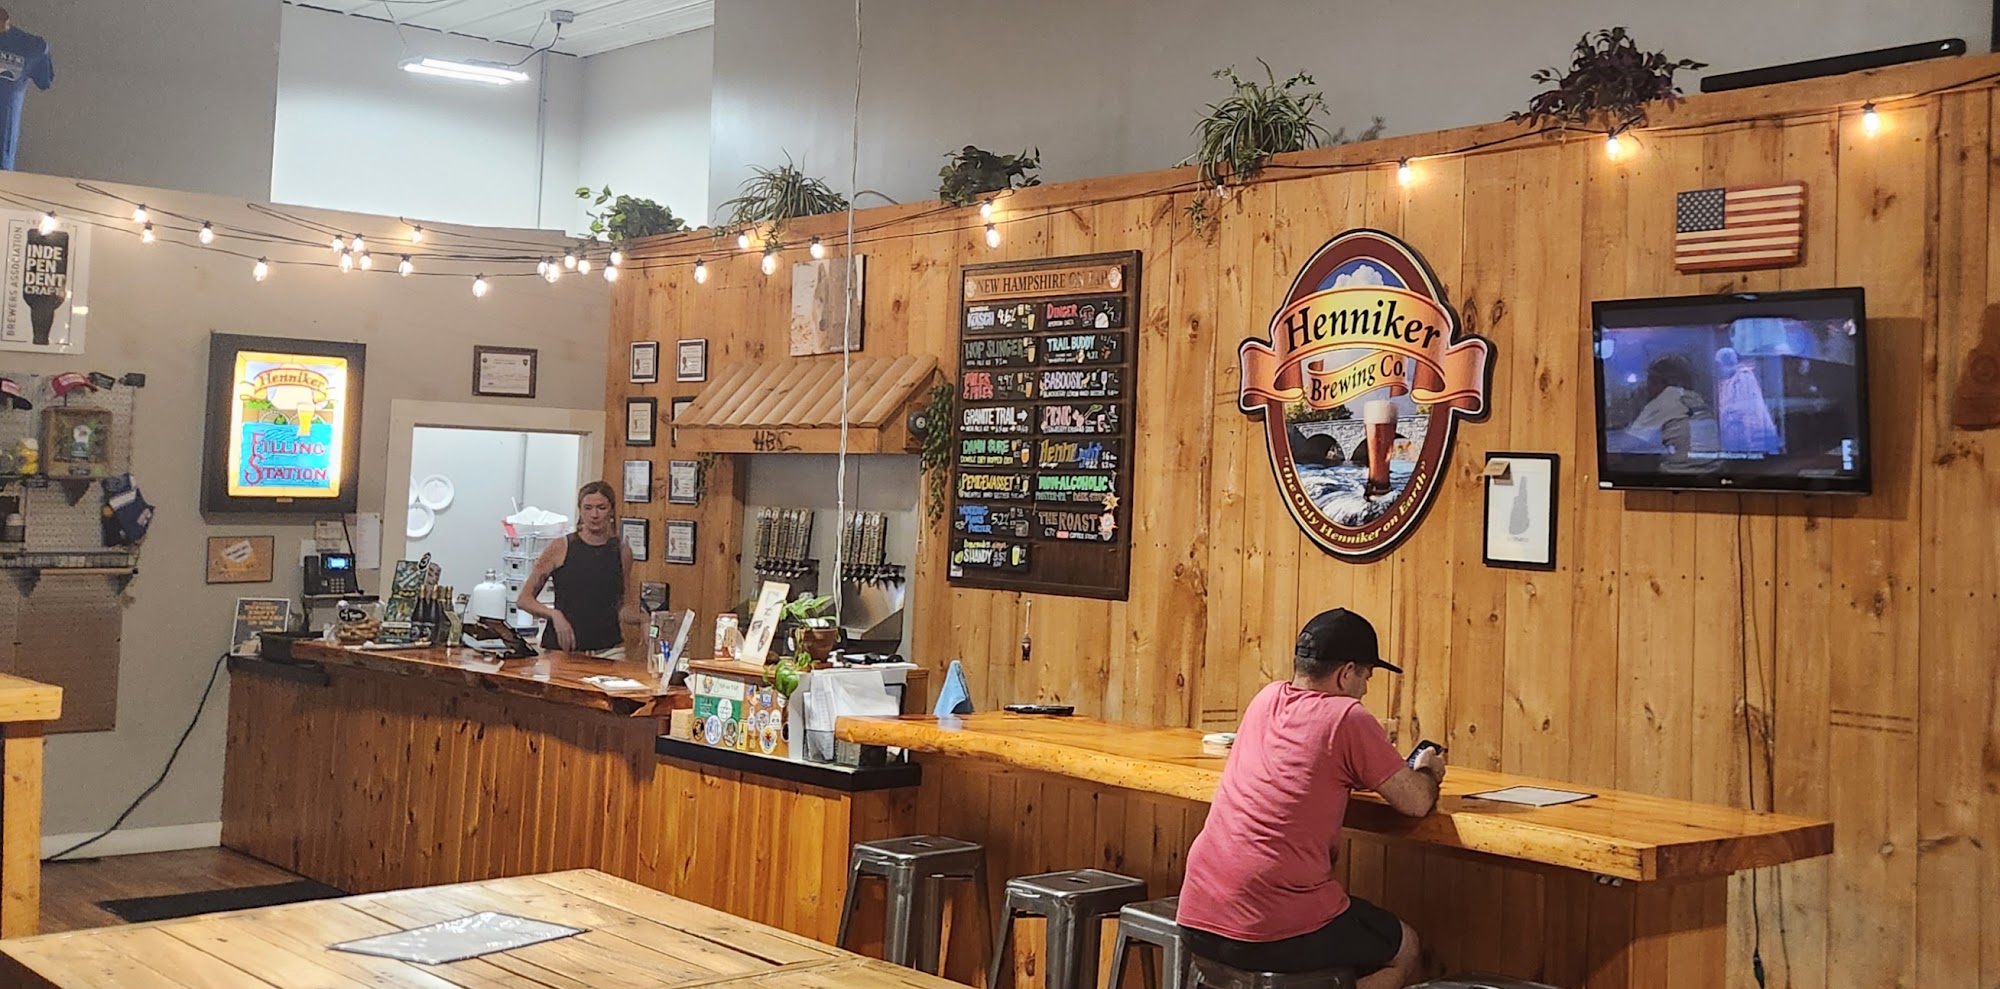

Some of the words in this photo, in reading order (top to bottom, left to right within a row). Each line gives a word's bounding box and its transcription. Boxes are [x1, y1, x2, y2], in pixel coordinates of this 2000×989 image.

[10, 226, 22, 288] ASSOCIATION
[27, 244, 63, 260] INDE
[26, 258, 57, 273] PEN
[25, 271, 66, 287] DENT
[977, 278, 1000, 293] NEW
[1003, 273, 1066, 293] HAMPSHIRE
[1069, 271, 1085, 288] ON
[1088, 269, 1108, 286] TAP
[24, 285, 60, 296] CRAFT
[6, 289, 18, 337] BREWERS
[1284, 299, 1441, 354] Henniker
[965, 341, 985, 359] HOP
[986, 339, 1024, 358] SLINGER
[1046, 336, 1070, 352] TRAIL
[1071, 335, 1096, 350] BUDDY
[260, 372, 326, 391] Henniker
[1044, 371, 1085, 390] BABOOSIC
[1310, 362, 1377, 401] Brewing
[1380, 354, 1406, 378] Co.
[964, 407, 994, 425] GRANITE
[995, 407, 1017, 425] TRAIL
[1045, 405, 1072, 426] PICNIC
[252, 432, 326, 457] FILLING
[988, 439, 1010, 455] SURE
[244, 454, 328, 486] STATION
[962, 473, 1015, 491] PEMIGEWASSET
[1039, 475, 1108, 491] NON-ALCOHOLIC
[1039, 511, 1058, 525] THE
[1059, 511, 1098, 532] ROAST
[1295, 493, 1320, 525] Only
[1319, 522, 1382, 544] Henniker
[1383, 517, 1400, 532] on
[964, 549, 993, 564] SHANDY
